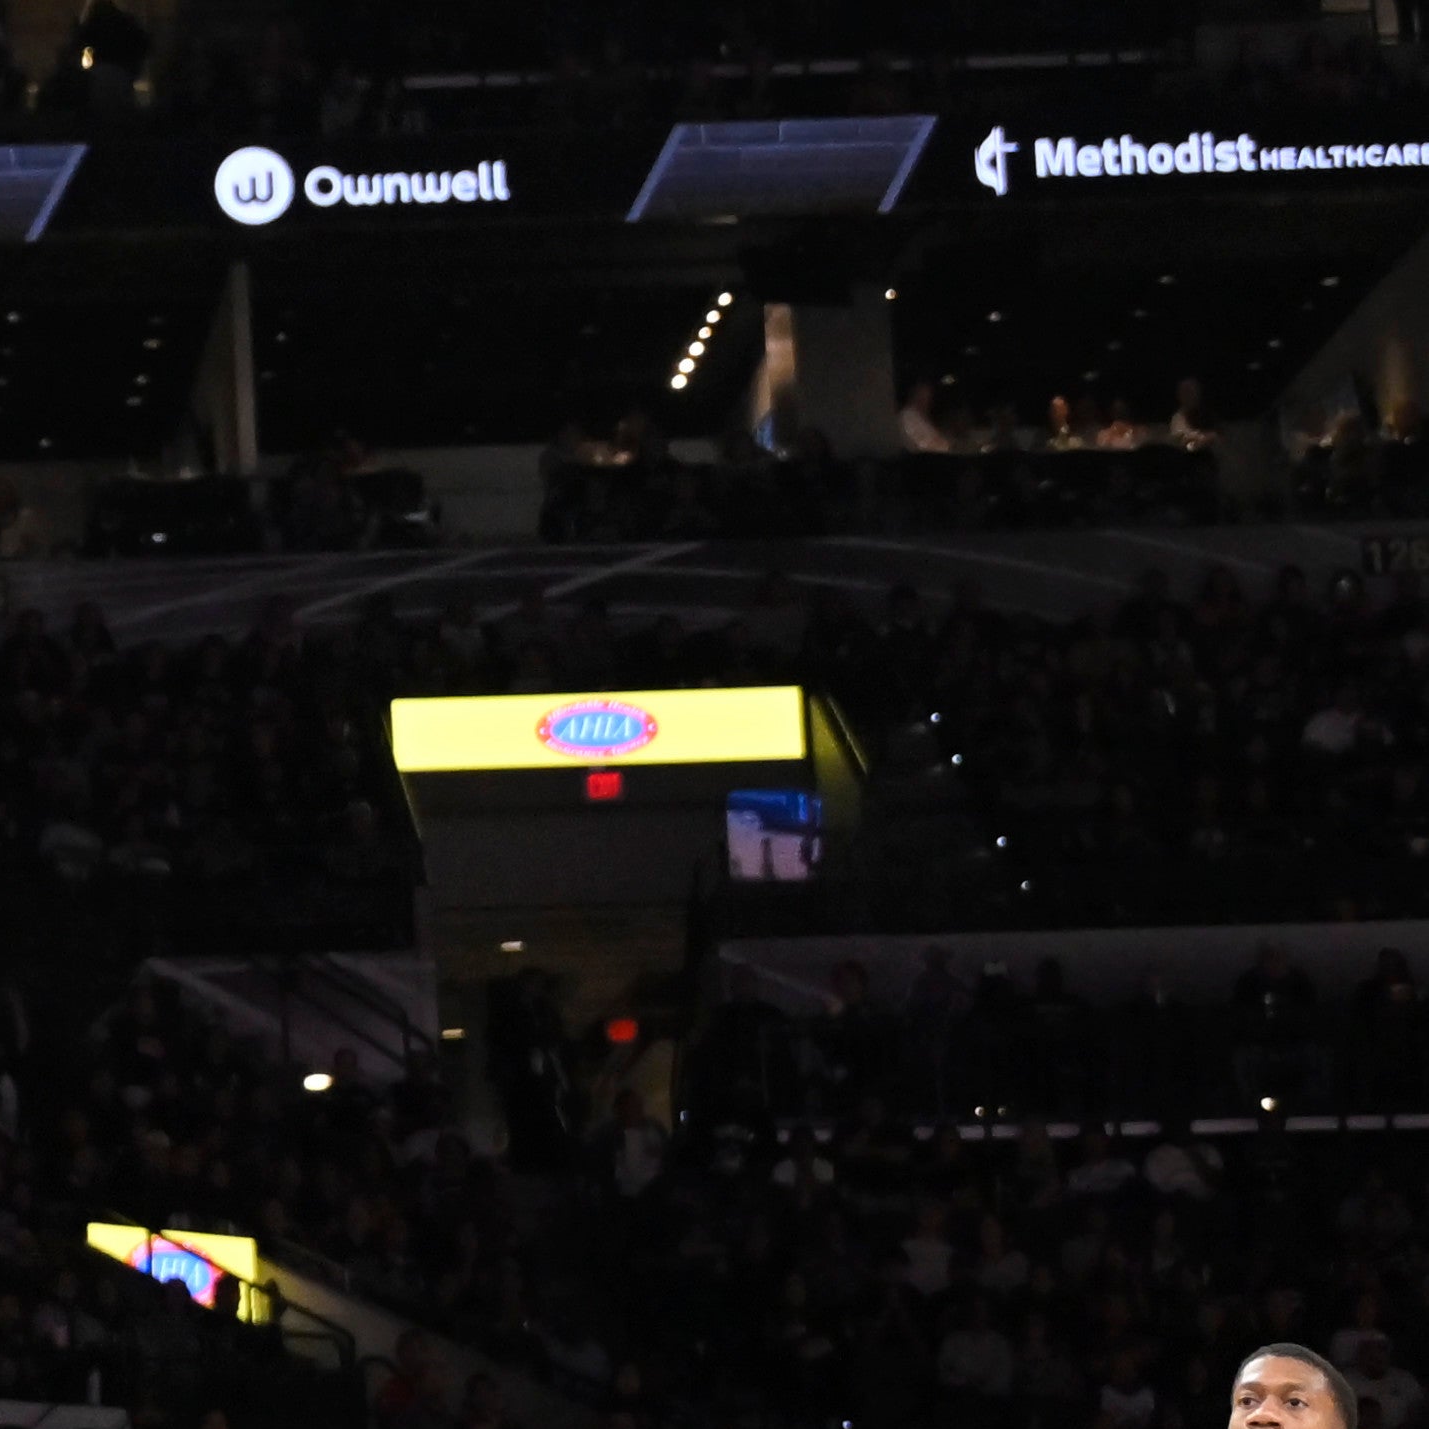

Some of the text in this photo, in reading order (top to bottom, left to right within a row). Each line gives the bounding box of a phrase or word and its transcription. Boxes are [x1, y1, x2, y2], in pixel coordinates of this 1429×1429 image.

[1035, 132, 1429, 178] Methodist HEALTHCARE
[304, 160, 511, 207] Ownwell
